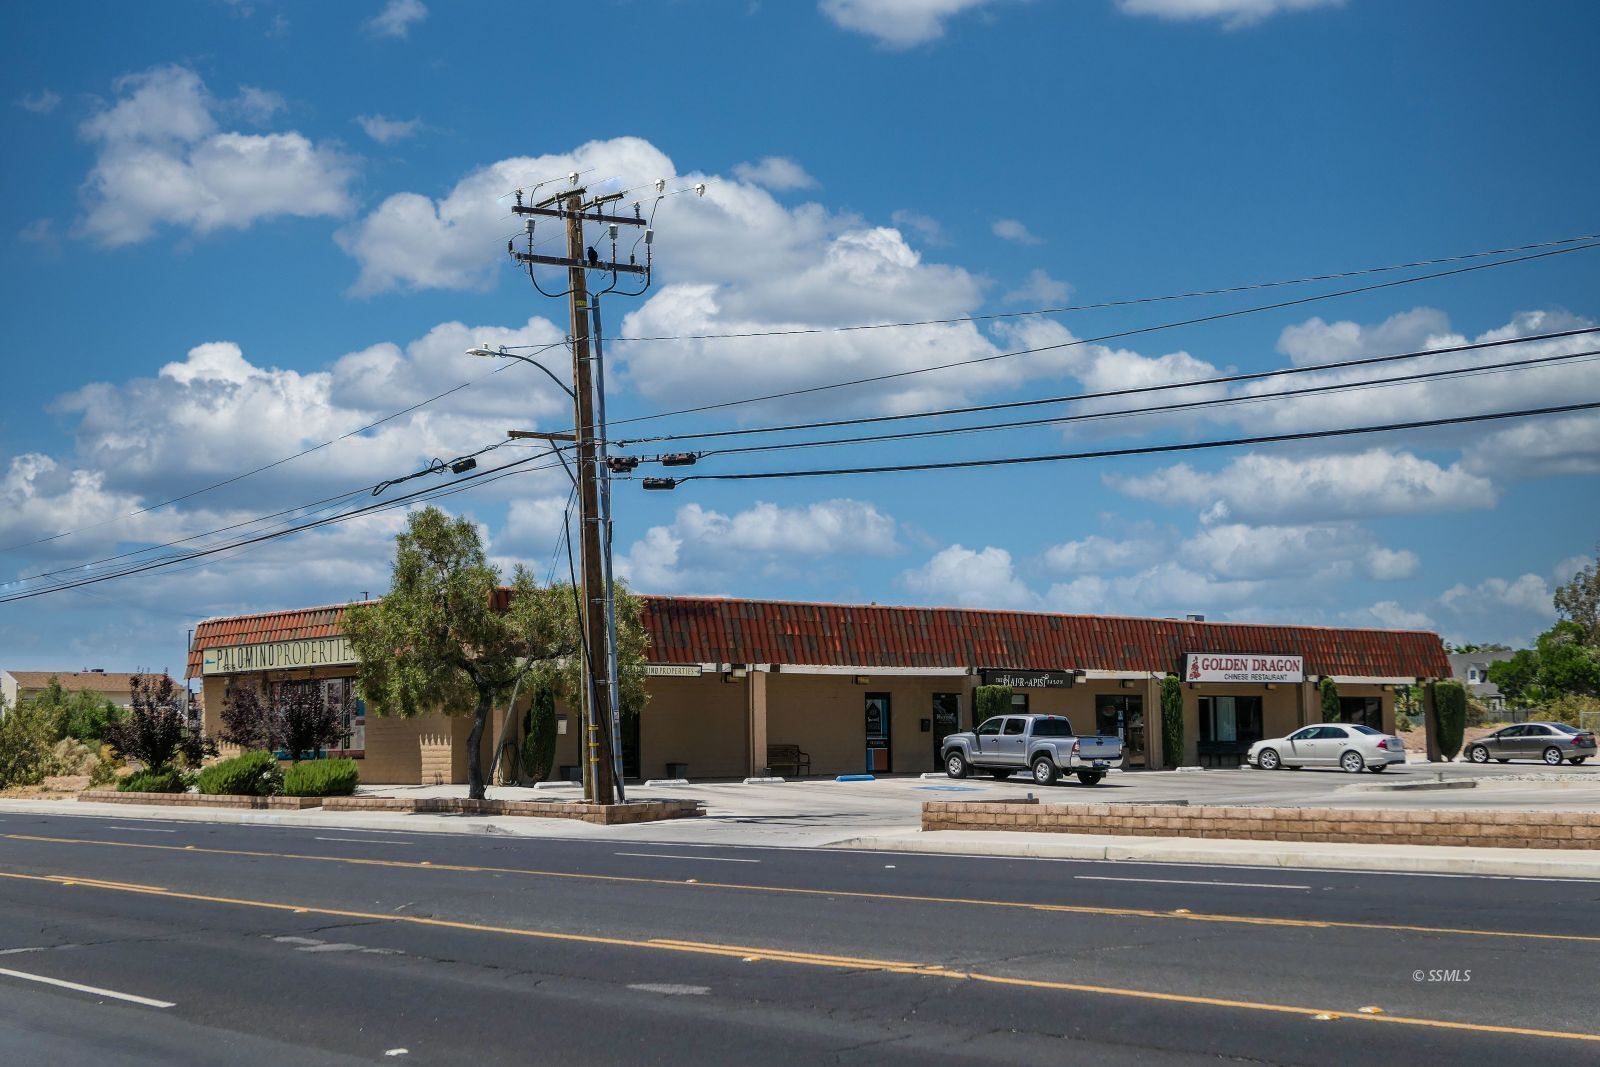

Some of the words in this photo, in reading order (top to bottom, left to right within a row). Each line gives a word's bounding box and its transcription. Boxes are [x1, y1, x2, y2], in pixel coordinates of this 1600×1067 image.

[1201, 657, 1249, 671] GOLDEN
[1252, 658, 1300, 672] DRAGON
[1251, 673, 1288, 681] RESTAURANT
